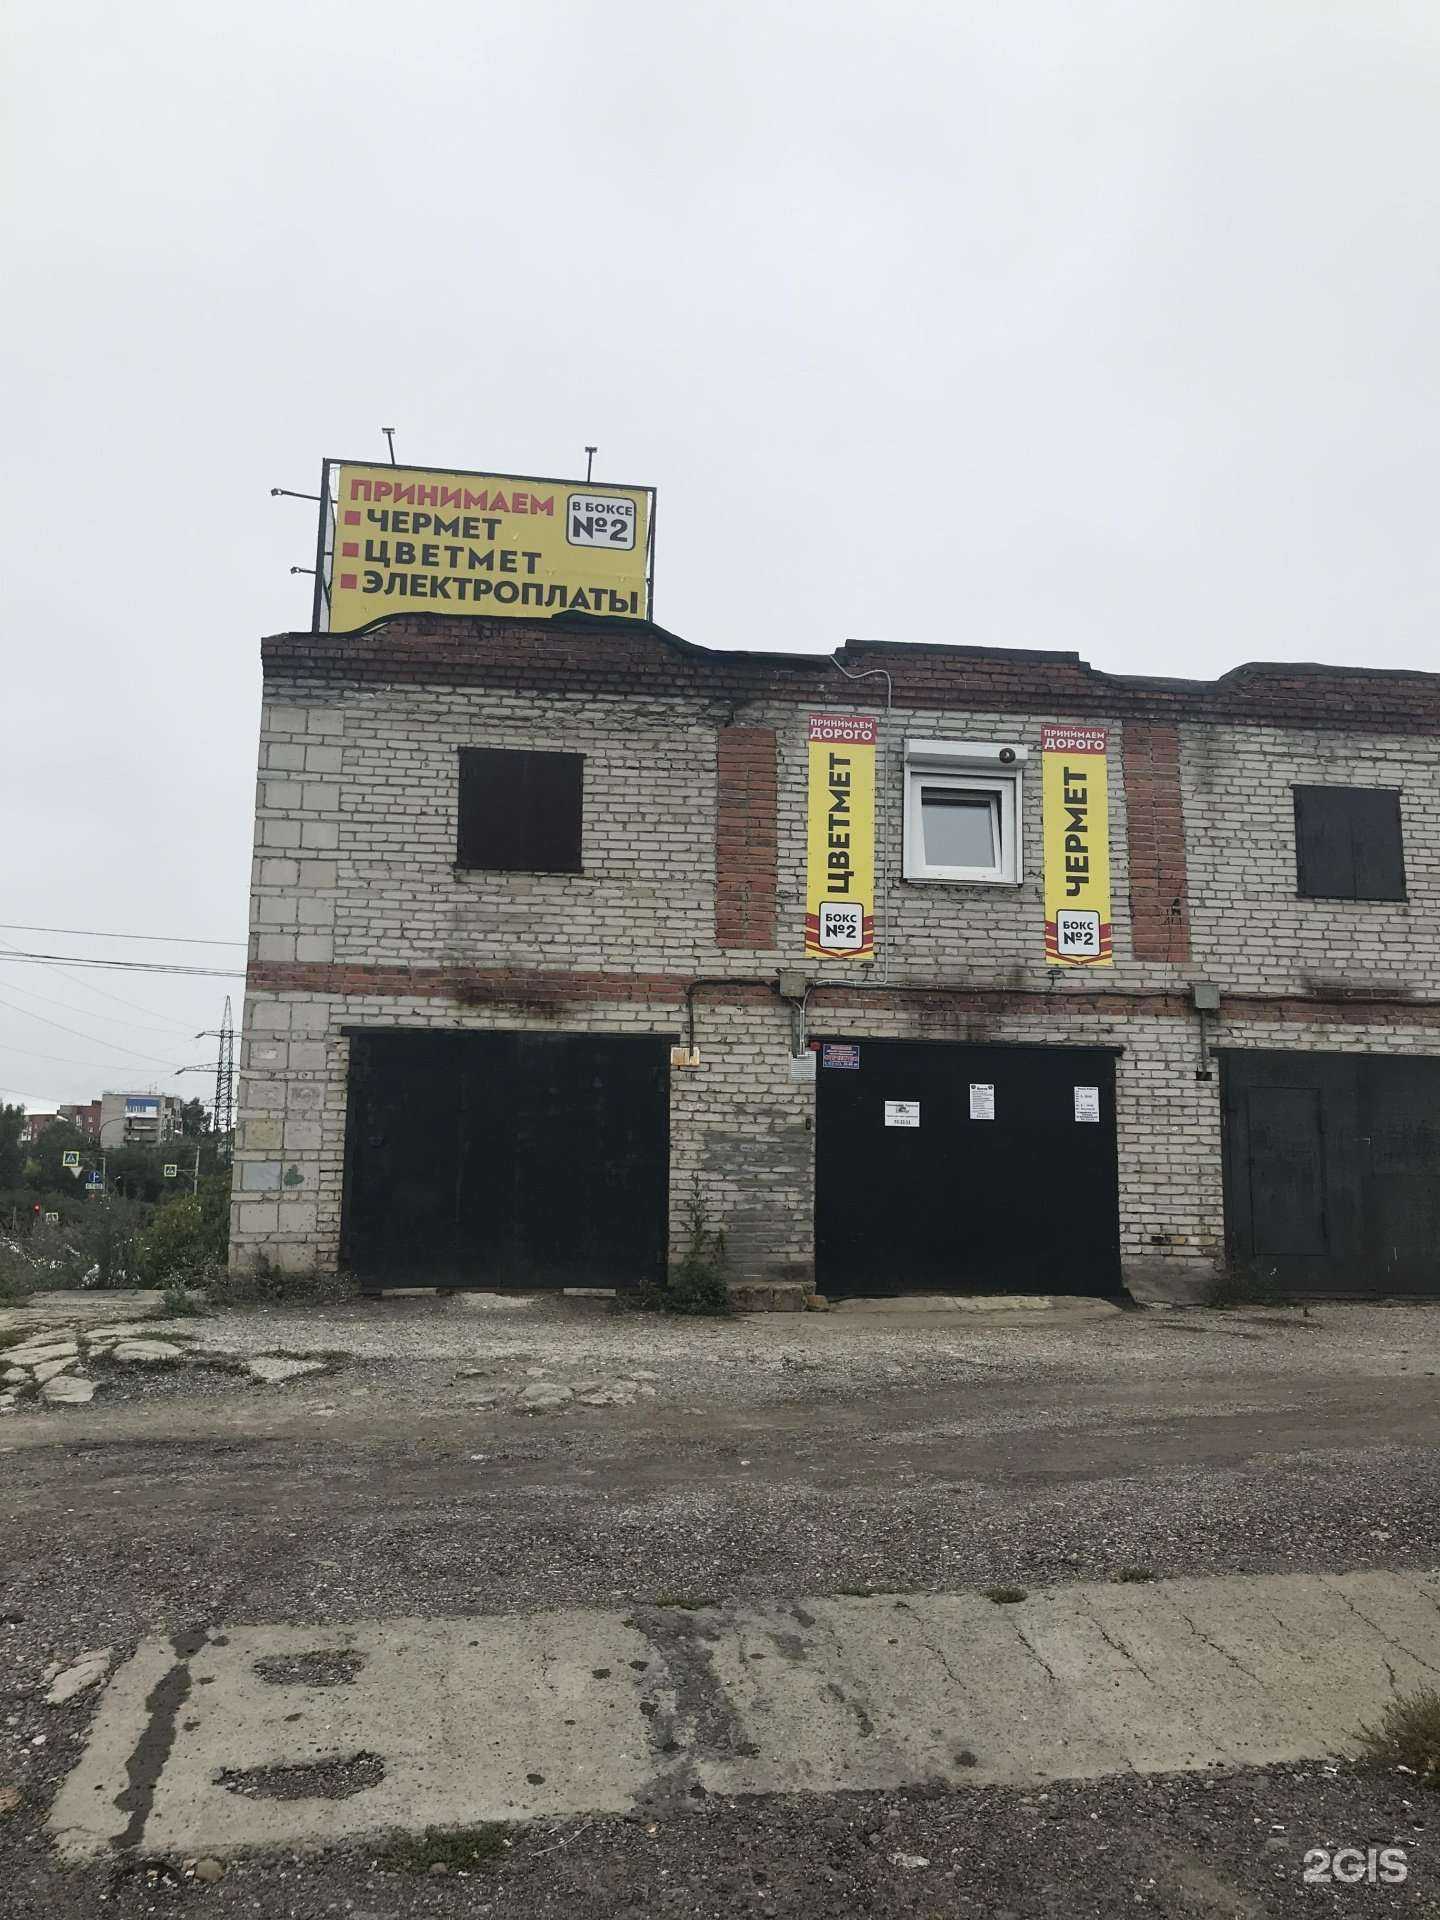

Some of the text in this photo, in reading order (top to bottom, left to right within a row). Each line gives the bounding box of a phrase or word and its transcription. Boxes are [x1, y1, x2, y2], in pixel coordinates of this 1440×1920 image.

[350, 478, 554, 516] ПРИНИМАЕМ
[572, 501, 633, 516] В БОКСЕ
[367, 509, 502, 541] ЧЕРМЕТ
[572, 514, 628, 543] №2
[364, 539, 542, 574] ЦВЕТМЕТ
[362, 570, 638, 614] ЭЛЕКТРОПЛАТЫ
[810, 718, 873, 729] ПРИНИМАЕМ
[810, 727, 873, 741] ДОРОГО
[1044, 729, 1105, 740] ПРИНИМАЕМ
[1044, 738, 1105, 751] ДОРОГО
[827, 752, 854, 893] ЦВЕТМЕТ
[1063, 766, 1090, 897] ЧЕРМЕТ
[825, 913, 857, 923] БОКС
[825, 924, 857, 938] №2
[1063, 921, 1094, 931] БОКС
[1063, 932, 1094, 946] №2
